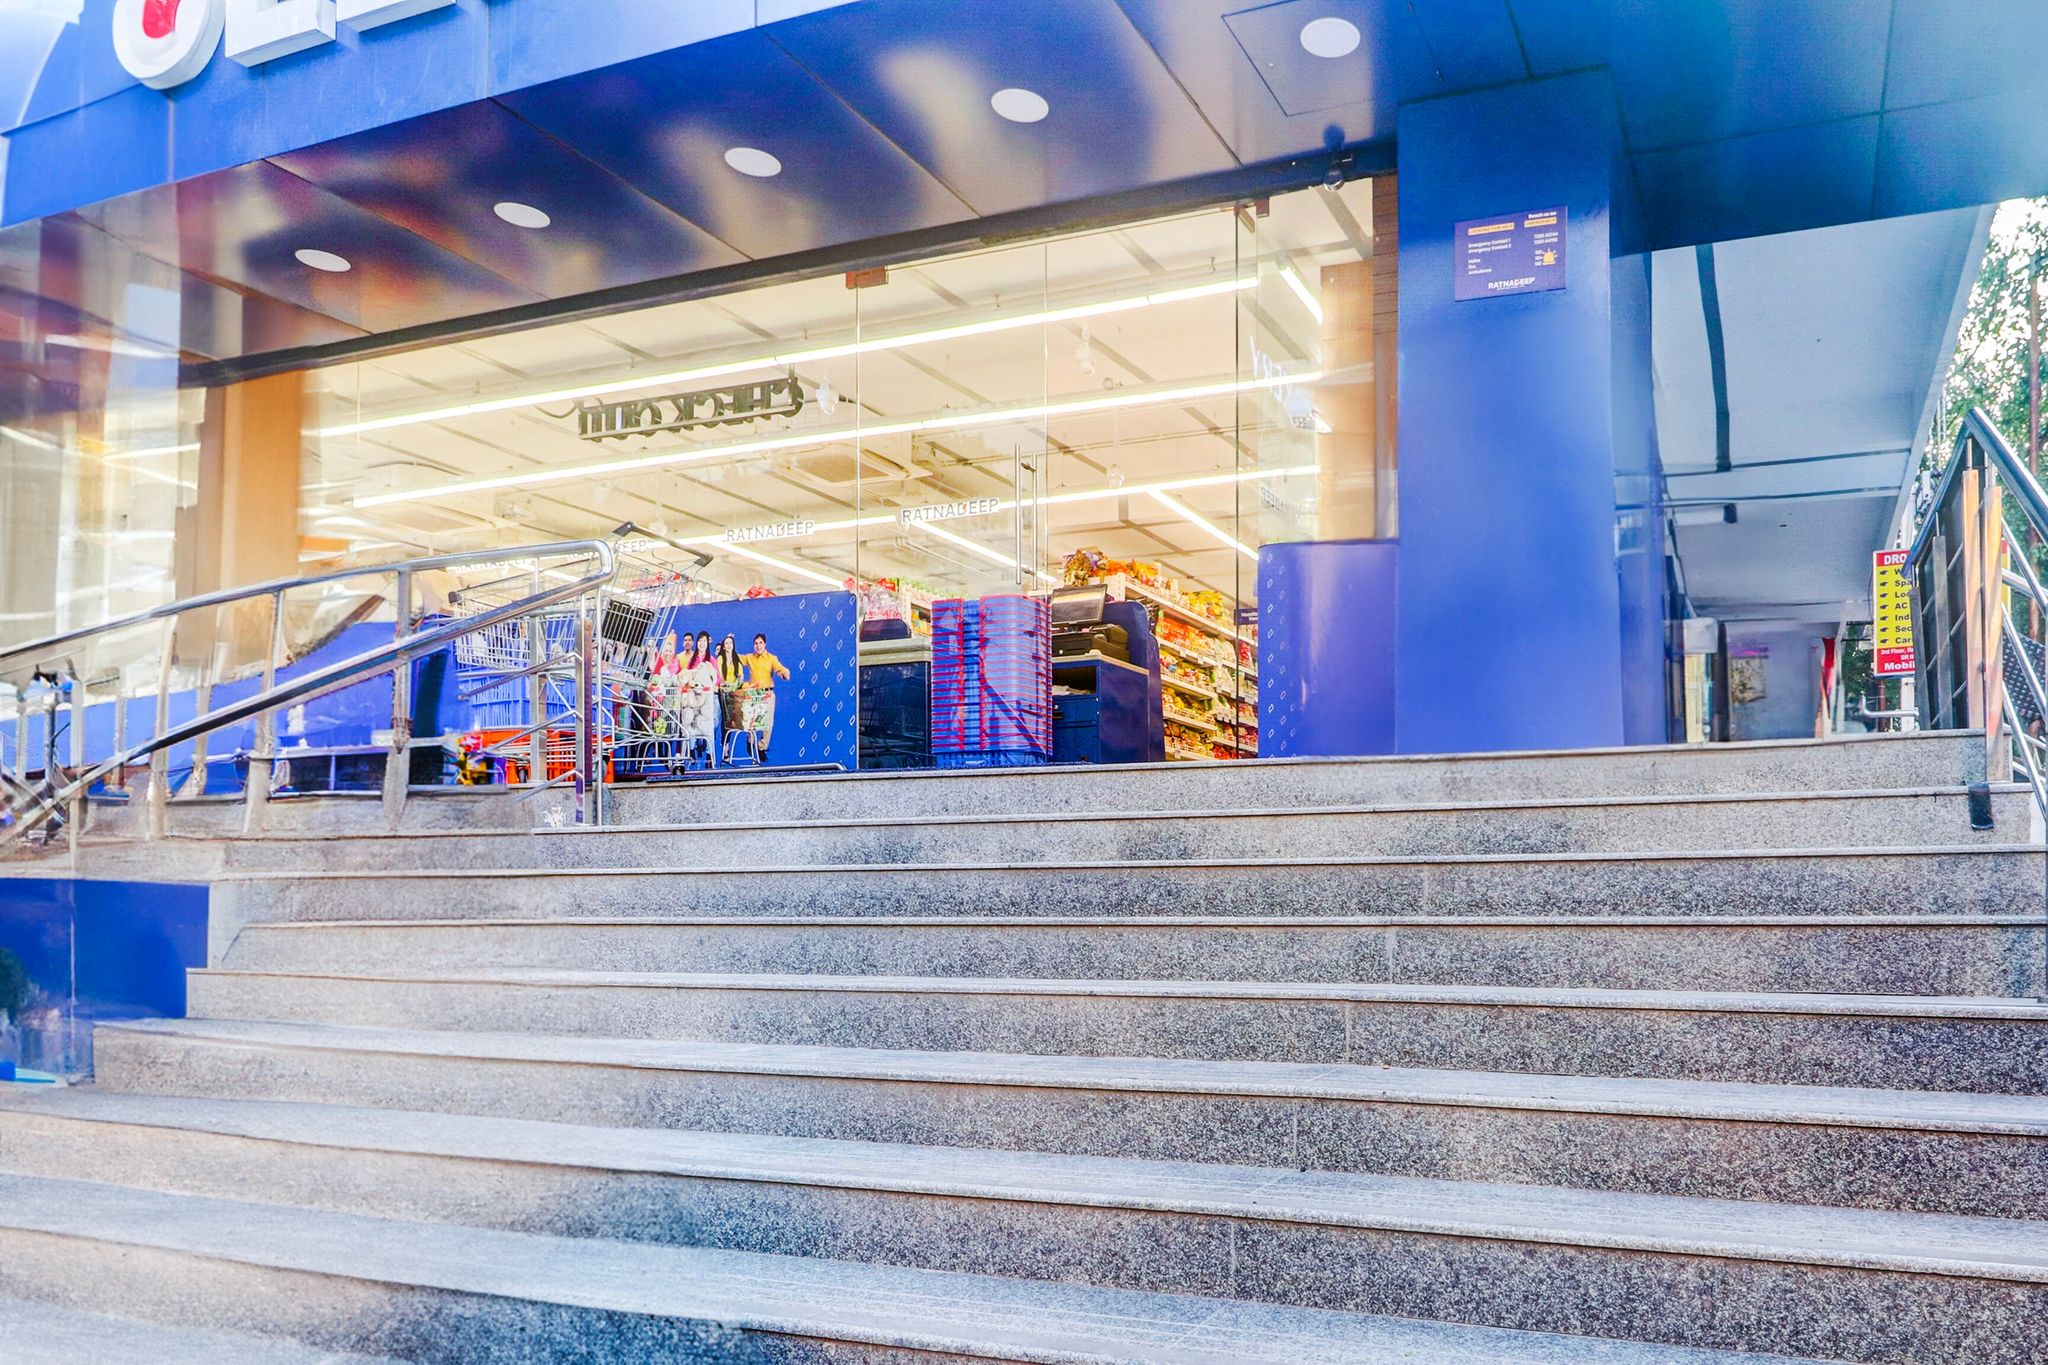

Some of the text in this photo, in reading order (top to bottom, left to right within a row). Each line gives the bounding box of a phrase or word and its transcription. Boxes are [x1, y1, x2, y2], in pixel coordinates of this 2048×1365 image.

[1488, 277, 1535, 289] RATNADEEP
[902, 499, 999, 523] RATNADEEP
[727, 521, 814, 542] RATNADEEP
